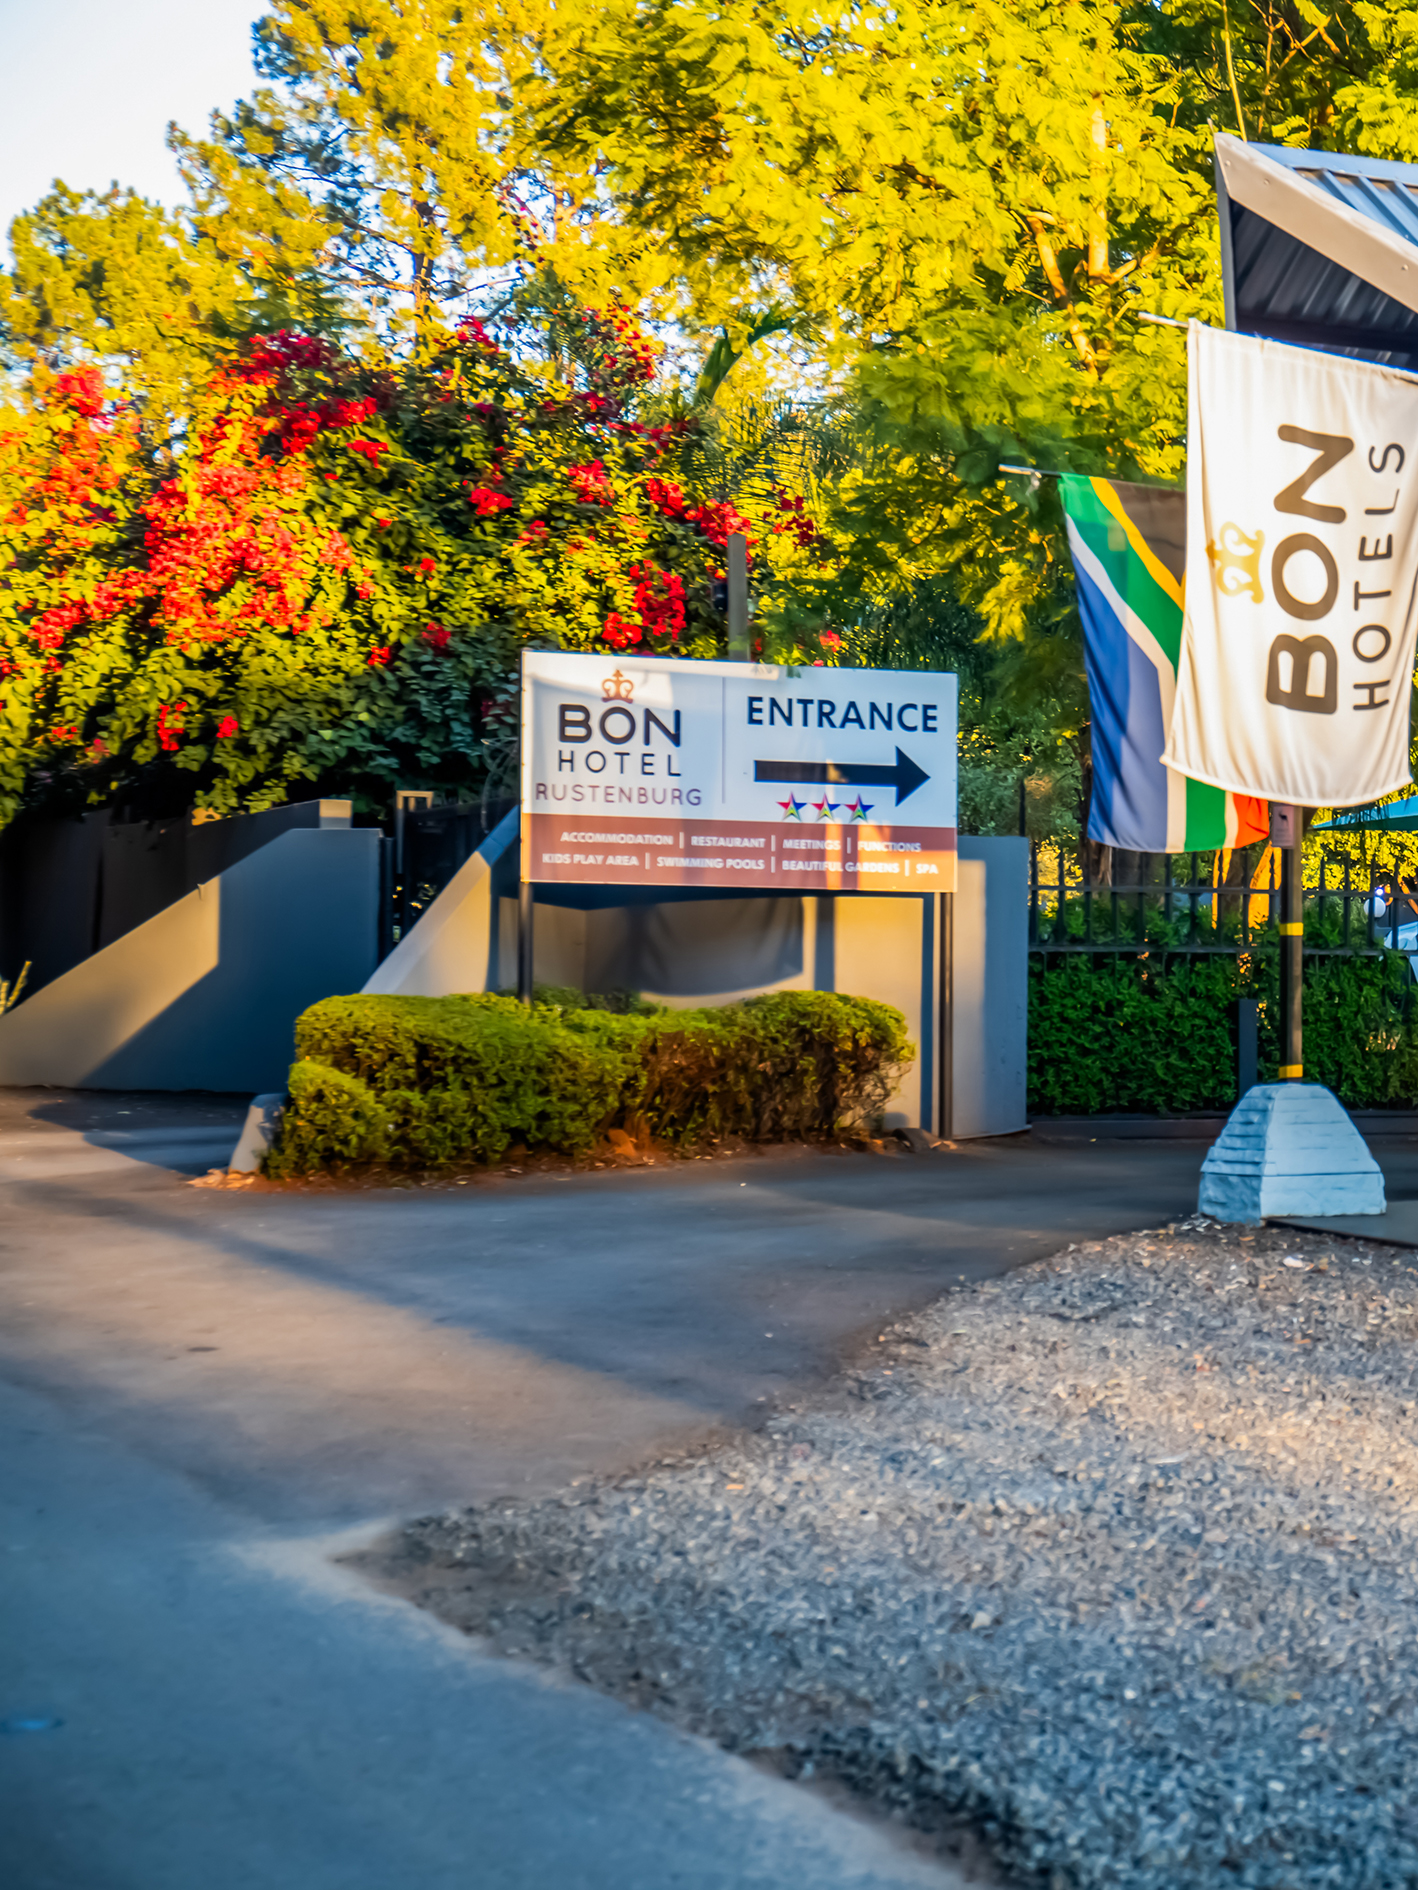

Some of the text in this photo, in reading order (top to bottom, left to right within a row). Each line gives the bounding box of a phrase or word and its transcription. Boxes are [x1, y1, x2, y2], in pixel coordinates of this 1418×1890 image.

[1266, 424, 1354, 714] BON
[1353, 443, 1405, 712] HOTELS
[558, 703, 682, 748] BON
[747, 696, 938, 733] ENTRANCE
[558, 750, 682, 777] HOTEL
[535, 782, 703, 806] RUSTENBURG
[560, 831, 922, 853] ACCOMMODATION RESTAURANT MEETINGS FUNCTIONS
[542, 853, 940, 875] KIDS PLAY AREA SWIMMING POOLS BEAUTIFUL GARDENS SPA
